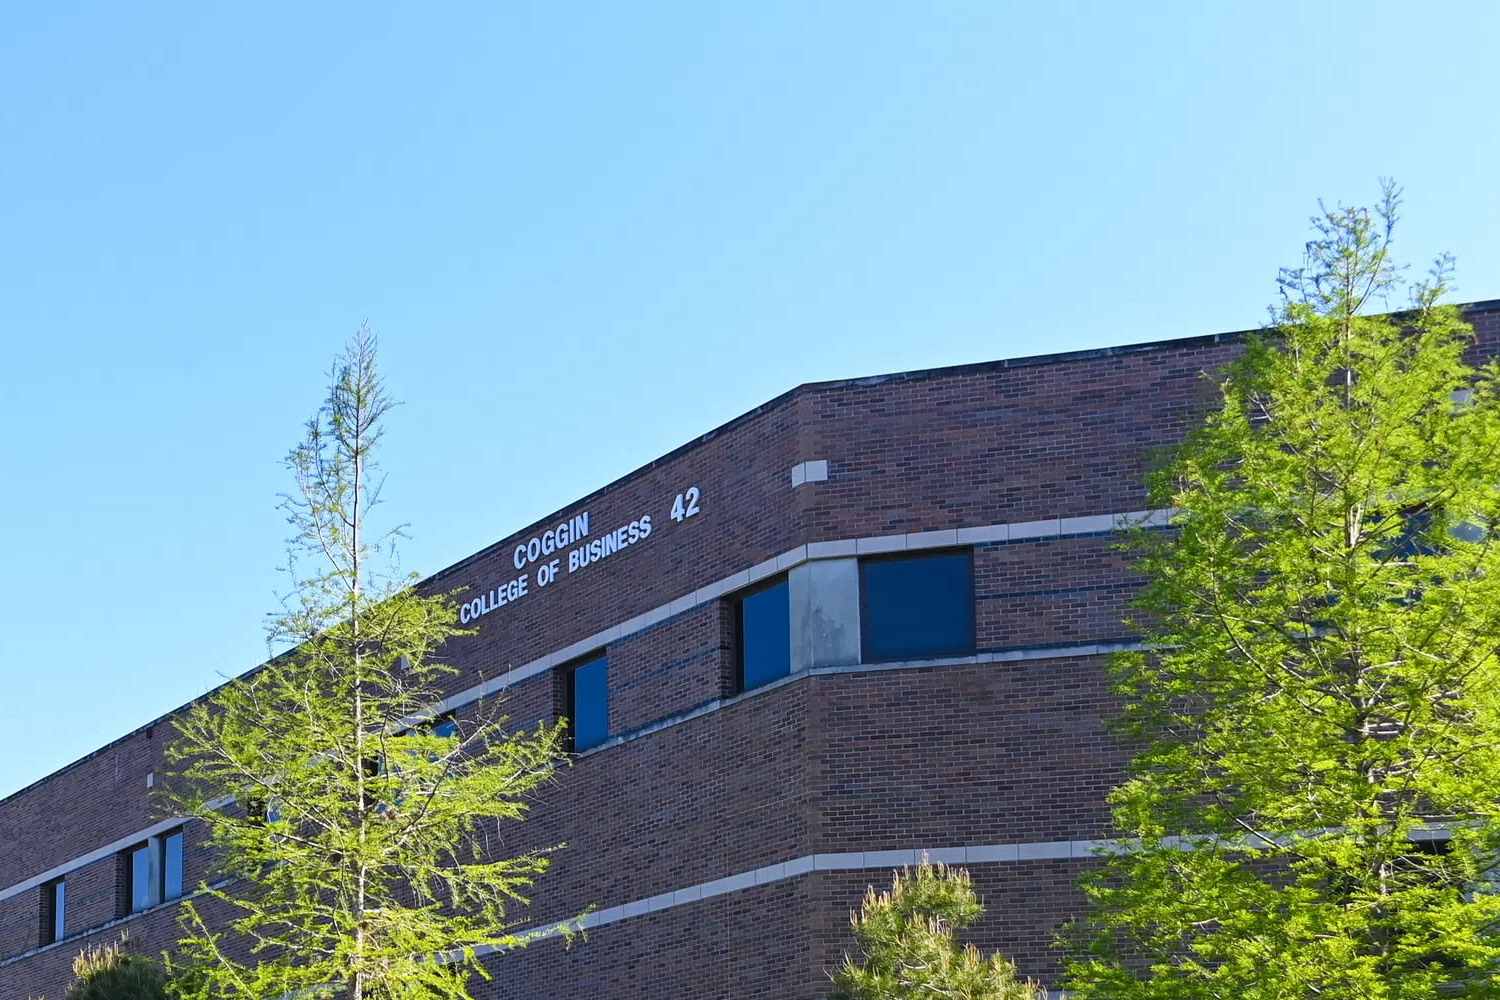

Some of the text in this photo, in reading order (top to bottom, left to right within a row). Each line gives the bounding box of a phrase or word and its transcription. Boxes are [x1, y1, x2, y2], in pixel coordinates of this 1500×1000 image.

[670, 487, 700, 522] 42
[514, 512, 589, 569] COGGIN
[460, 515, 652, 624] COLLEGE OF BUSINESS
